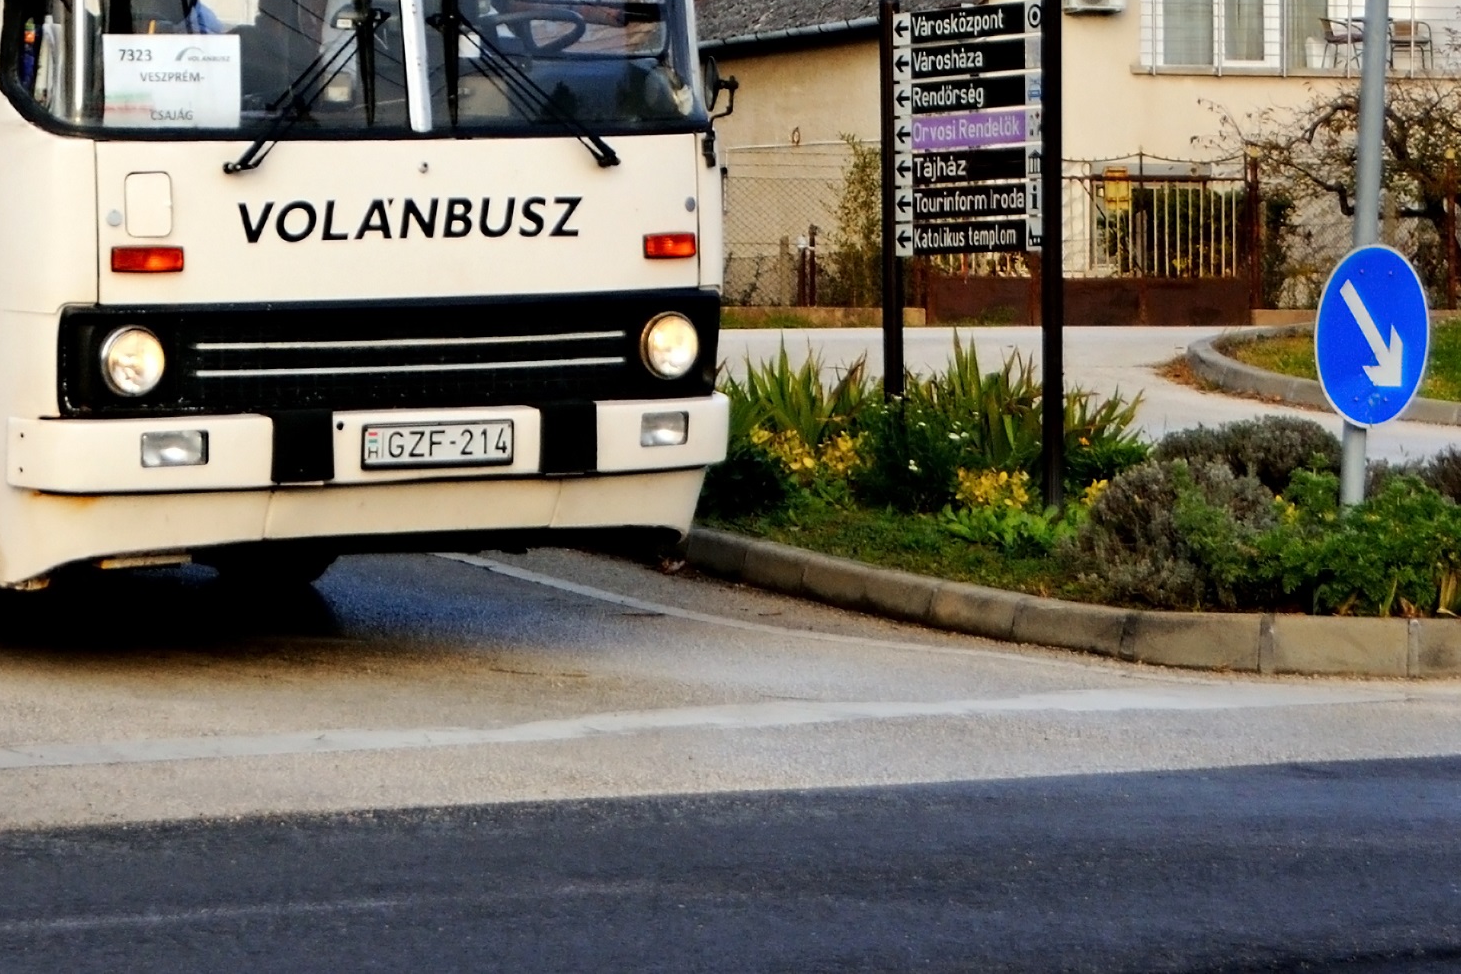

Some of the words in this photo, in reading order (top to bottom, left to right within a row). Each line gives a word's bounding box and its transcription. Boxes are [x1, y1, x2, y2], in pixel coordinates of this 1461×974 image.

[911, 9, 1004, 37] Városközpont
[118, 49, 152, 62] 7323
[912, 49, 983, 73] Városháza
[150, 108, 194, 121] CSAJÁG
[913, 120, 956, 143] Orvosi
[914, 156, 967, 182] Tájház
[914, 191, 988, 214] Tourinform
[990, 188, 1025, 209] Iroda
[237, 196, 583, 243] VOLÁNBUSZ
[913, 226, 965, 248] Katolikus
[968, 225, 1017, 249] templom
[368, 447, 379, 459] H
[388, 427, 508, 458] GZF-214
